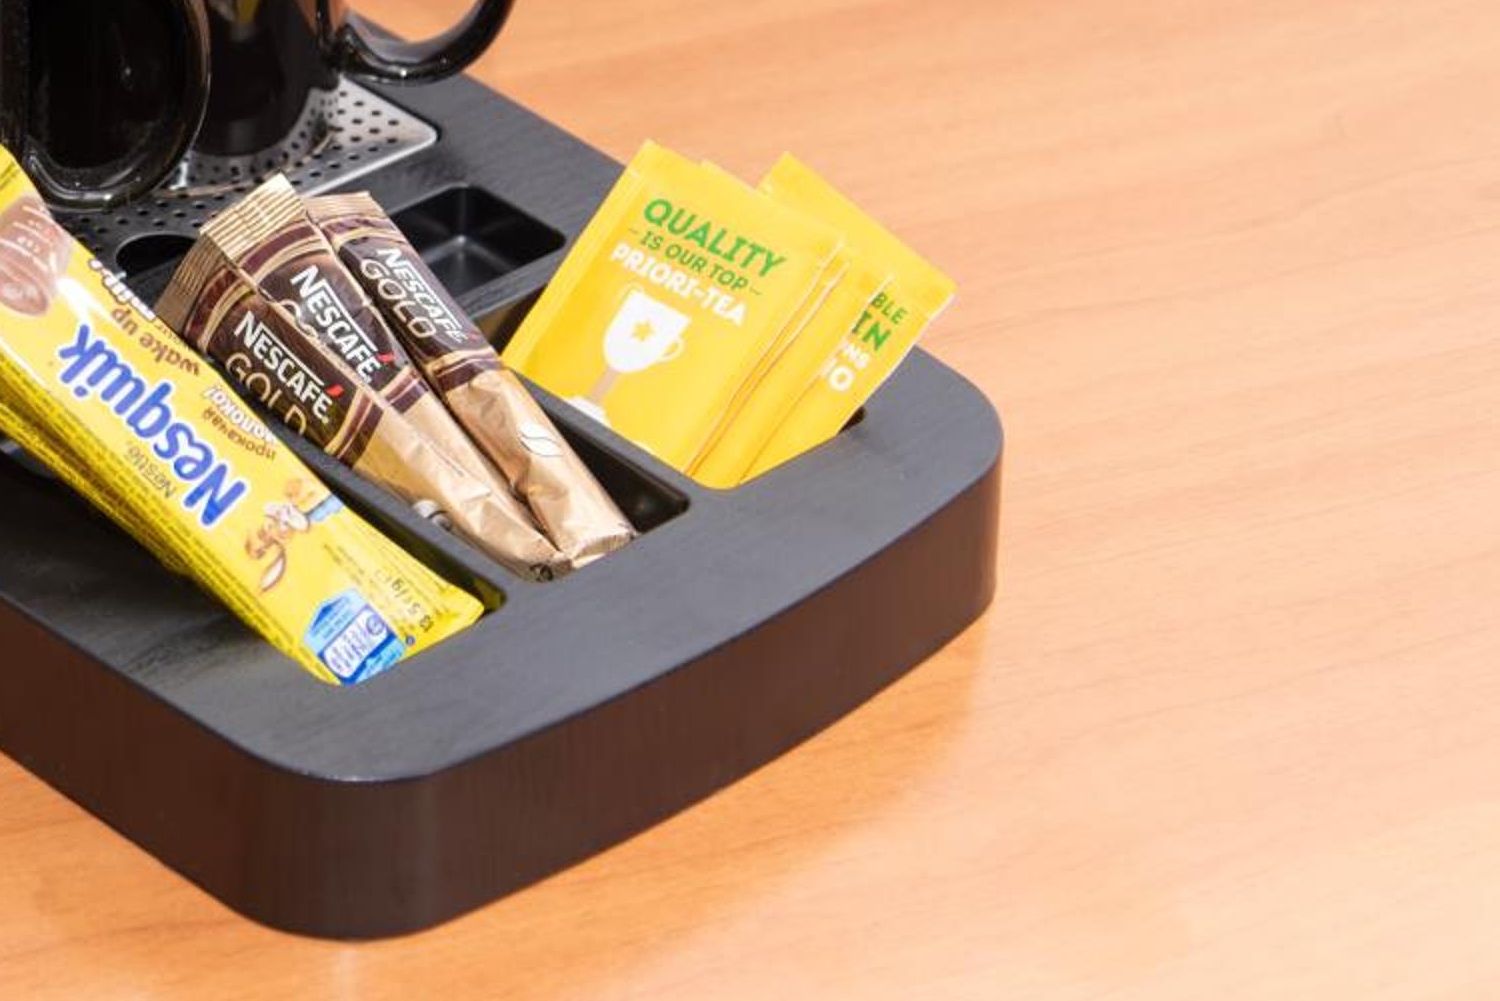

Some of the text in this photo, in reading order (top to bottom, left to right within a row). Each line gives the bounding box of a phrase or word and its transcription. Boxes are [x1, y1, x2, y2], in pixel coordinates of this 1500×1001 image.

[641, 230, 749, 291] IS OUR TOP
[643, 199, 787, 277] QUALITY
[361, 258, 437, 338] GOLD
[611, 242, 747, 328] PRIORI-TEA
[112, 306, 201, 376] wake up
[58, 324, 247, 526] Nesquik
